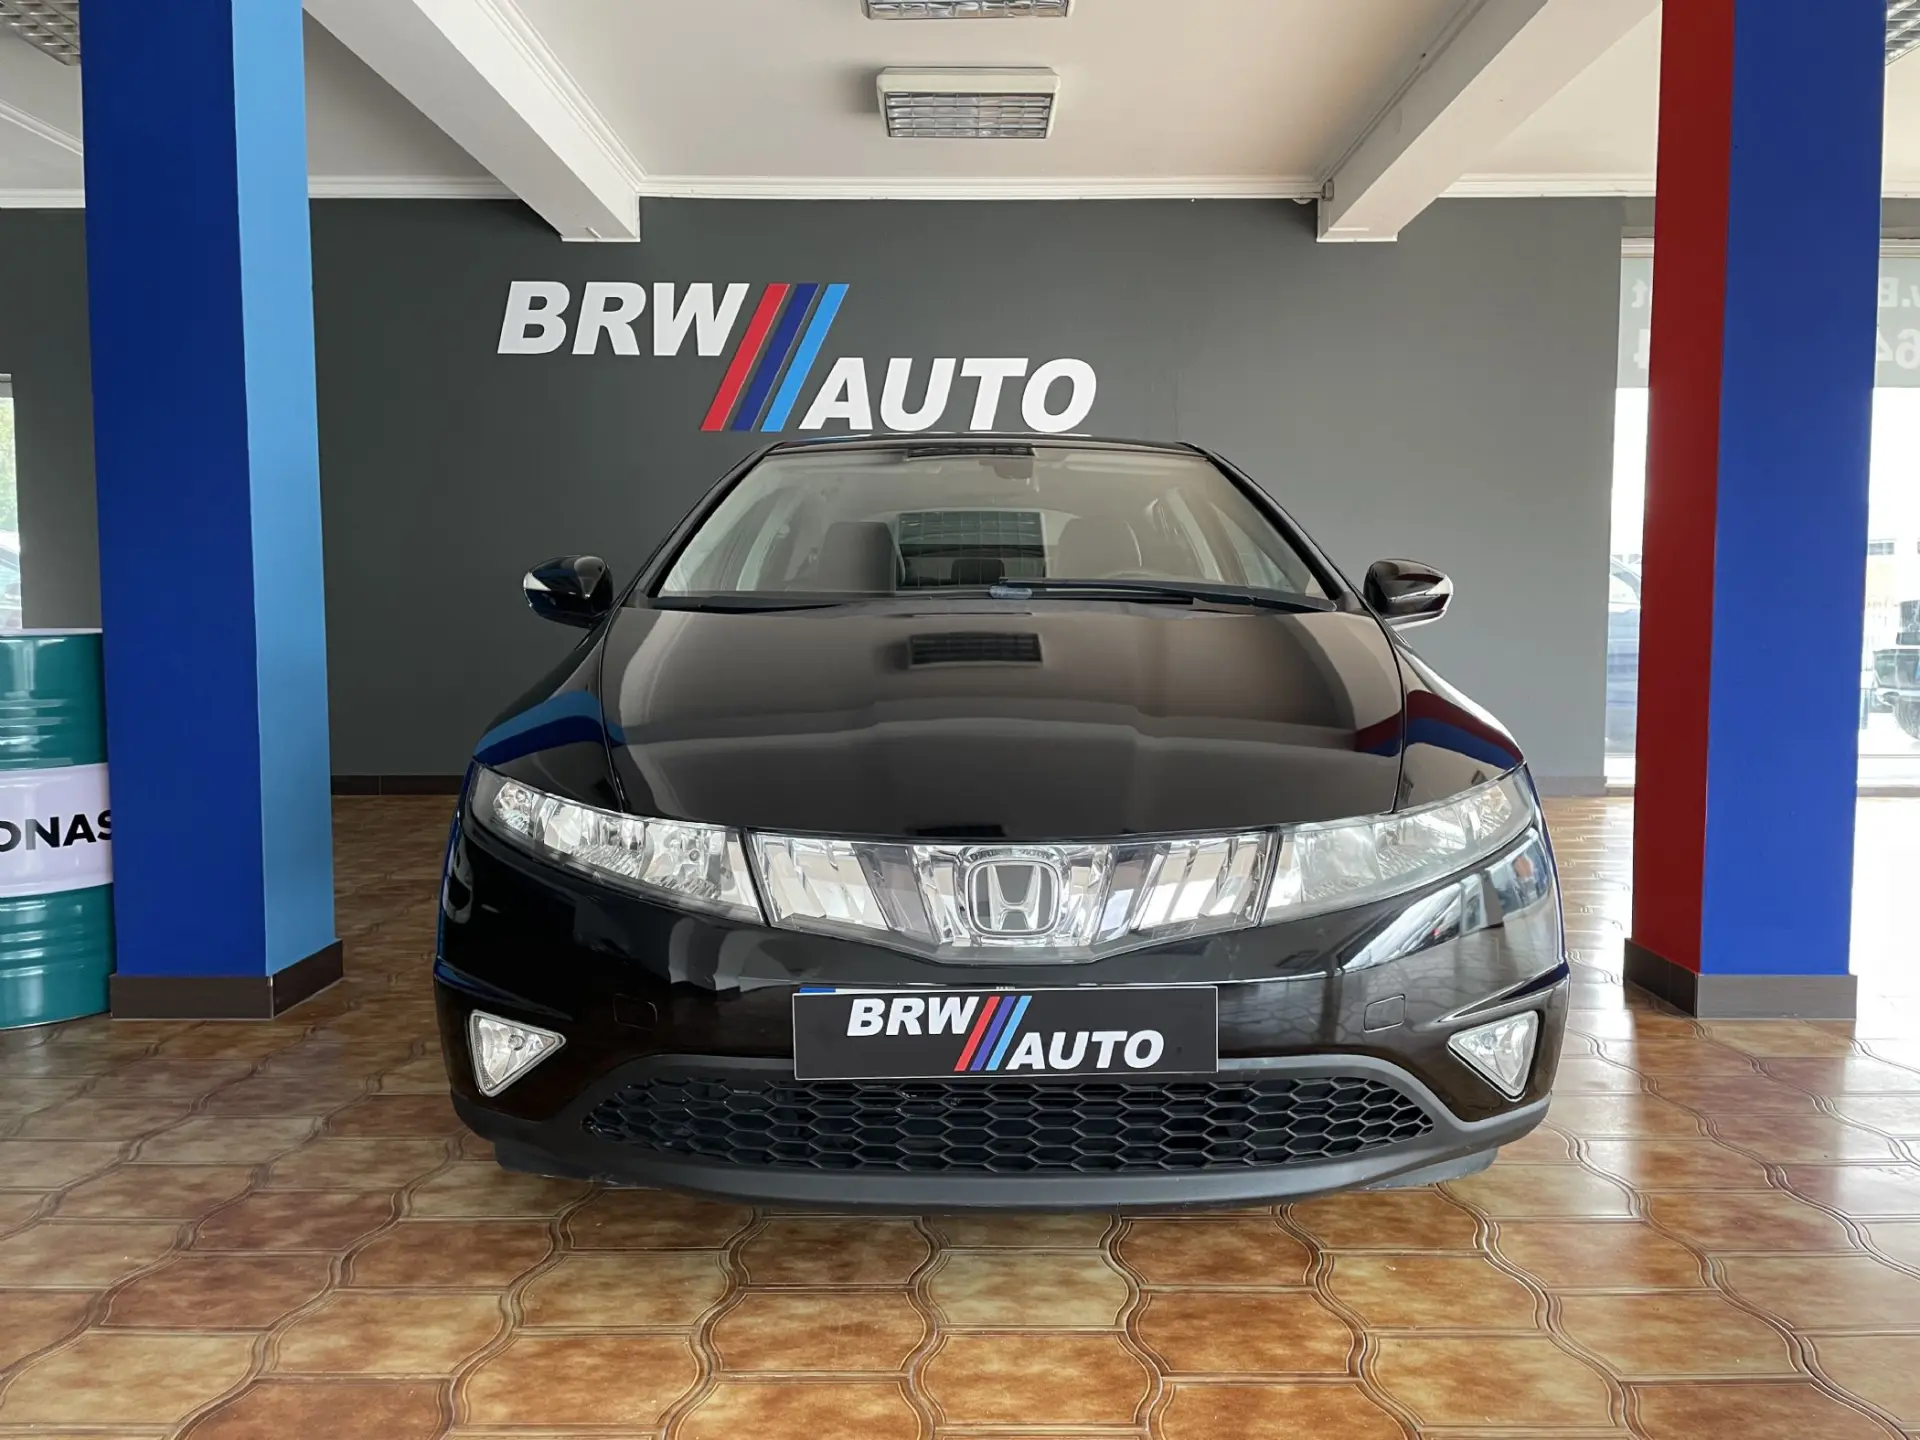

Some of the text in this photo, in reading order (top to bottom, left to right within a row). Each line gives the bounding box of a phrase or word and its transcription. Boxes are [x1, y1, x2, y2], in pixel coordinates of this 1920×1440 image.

[497, 281, 750, 356] BRW
[799, 357, 1097, 432] AUTO
[846, 996, 979, 1036] BRW
[1005, 1030, 1164, 1070] AUTO
